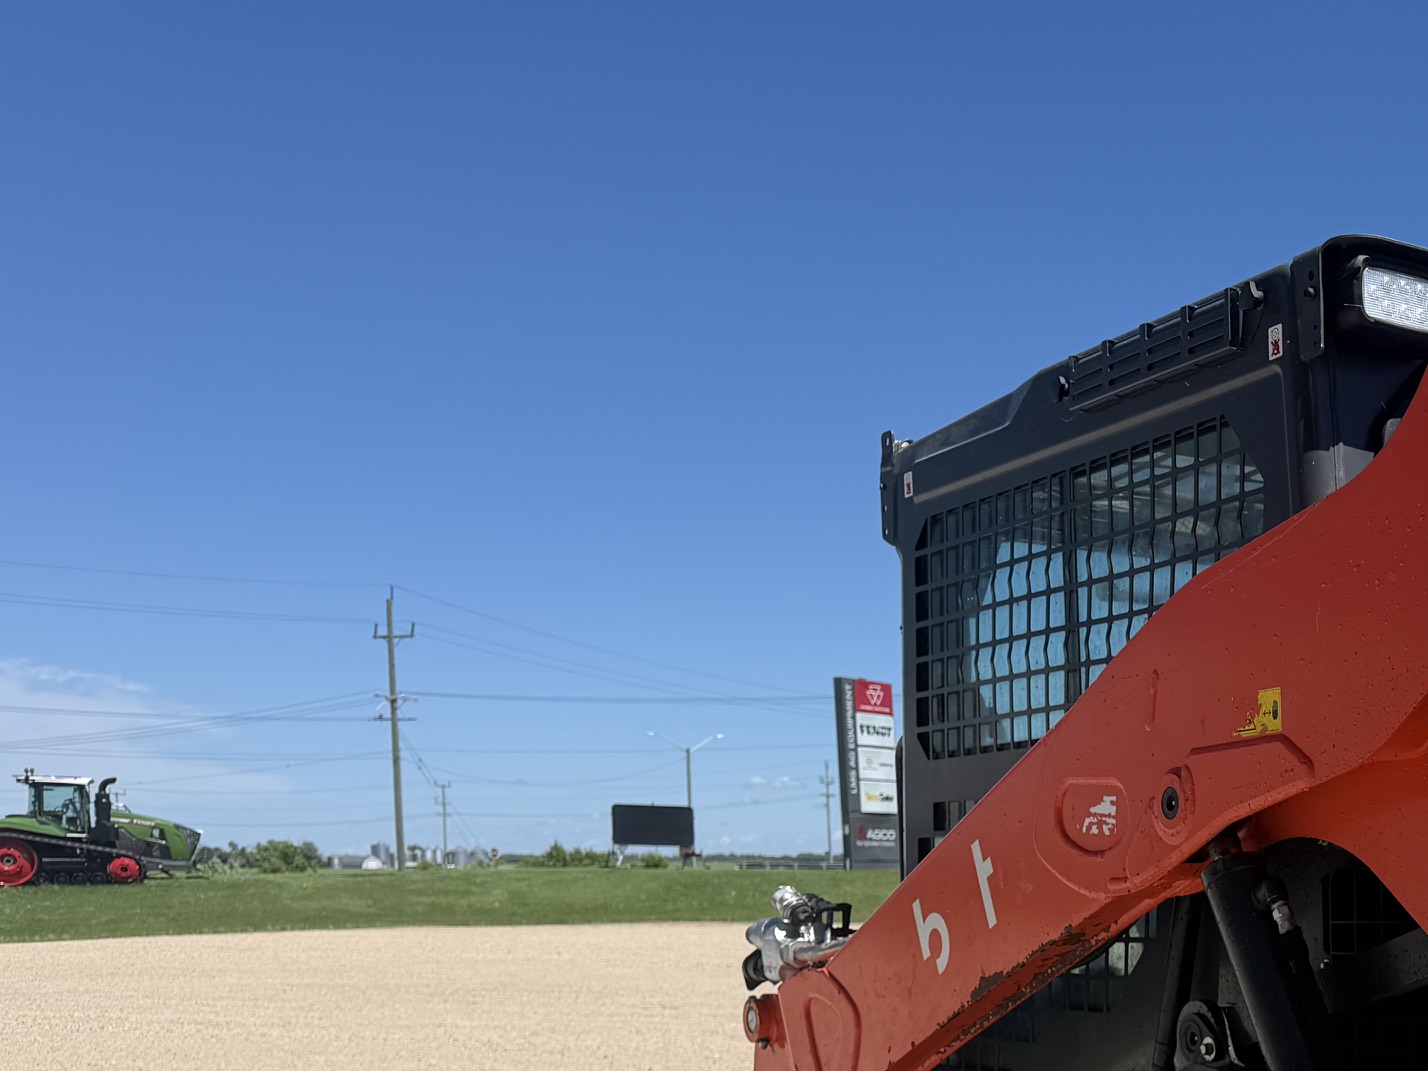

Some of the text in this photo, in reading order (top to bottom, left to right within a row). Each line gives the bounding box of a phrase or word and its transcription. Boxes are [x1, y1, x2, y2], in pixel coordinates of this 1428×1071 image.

[845, 683, 855, 749] EQUIPMENT
[859, 724, 892, 738] FENDT
[866, 828, 896, 841] AGCO
